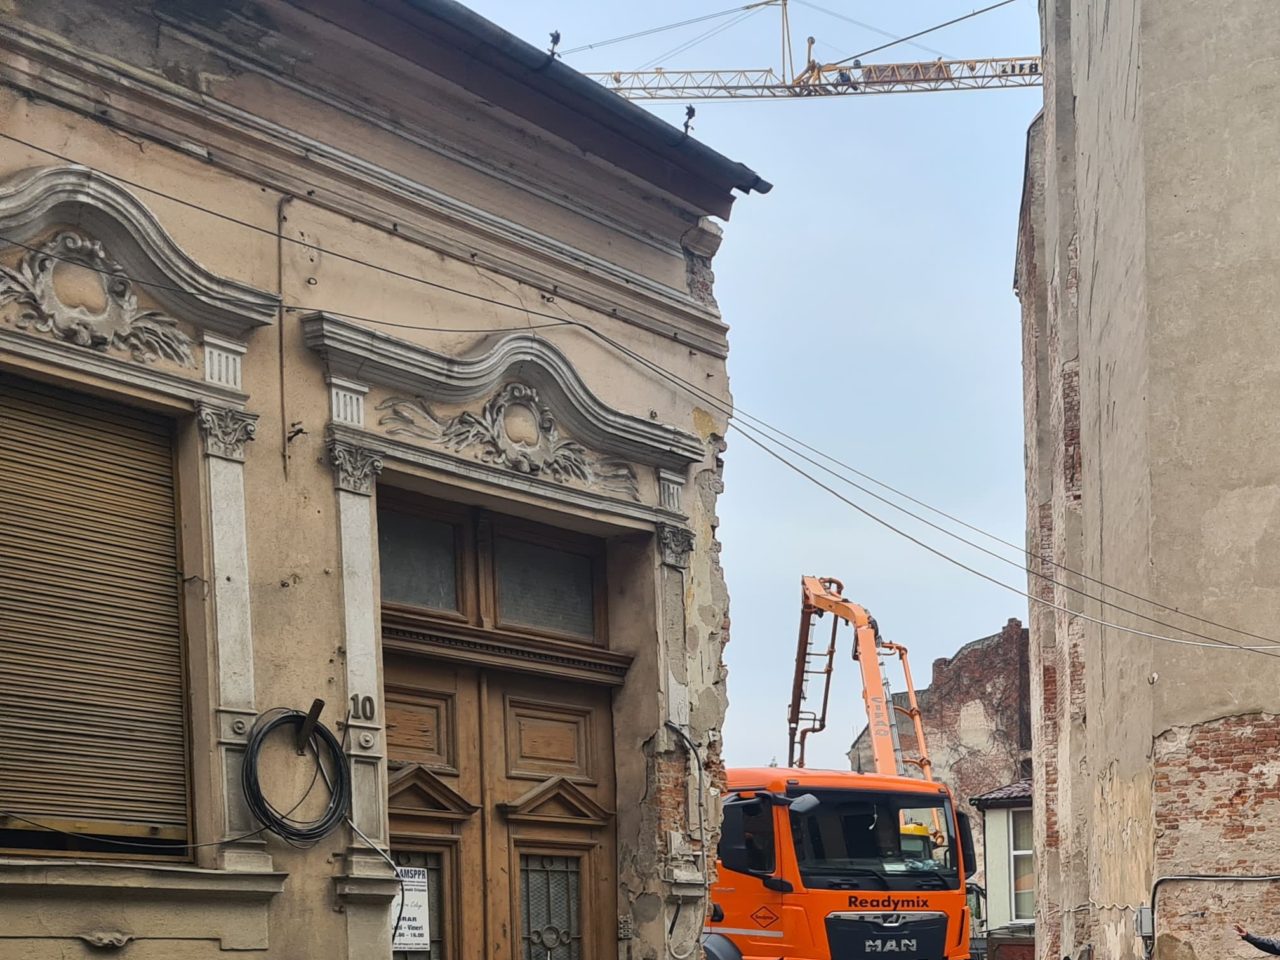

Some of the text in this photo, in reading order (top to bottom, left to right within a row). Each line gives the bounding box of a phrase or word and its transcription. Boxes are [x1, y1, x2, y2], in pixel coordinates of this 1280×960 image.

[350, 693, 375, 720] 10
[848, 895, 929, 911] Readymix
[865, 939, 917, 952] MAN
